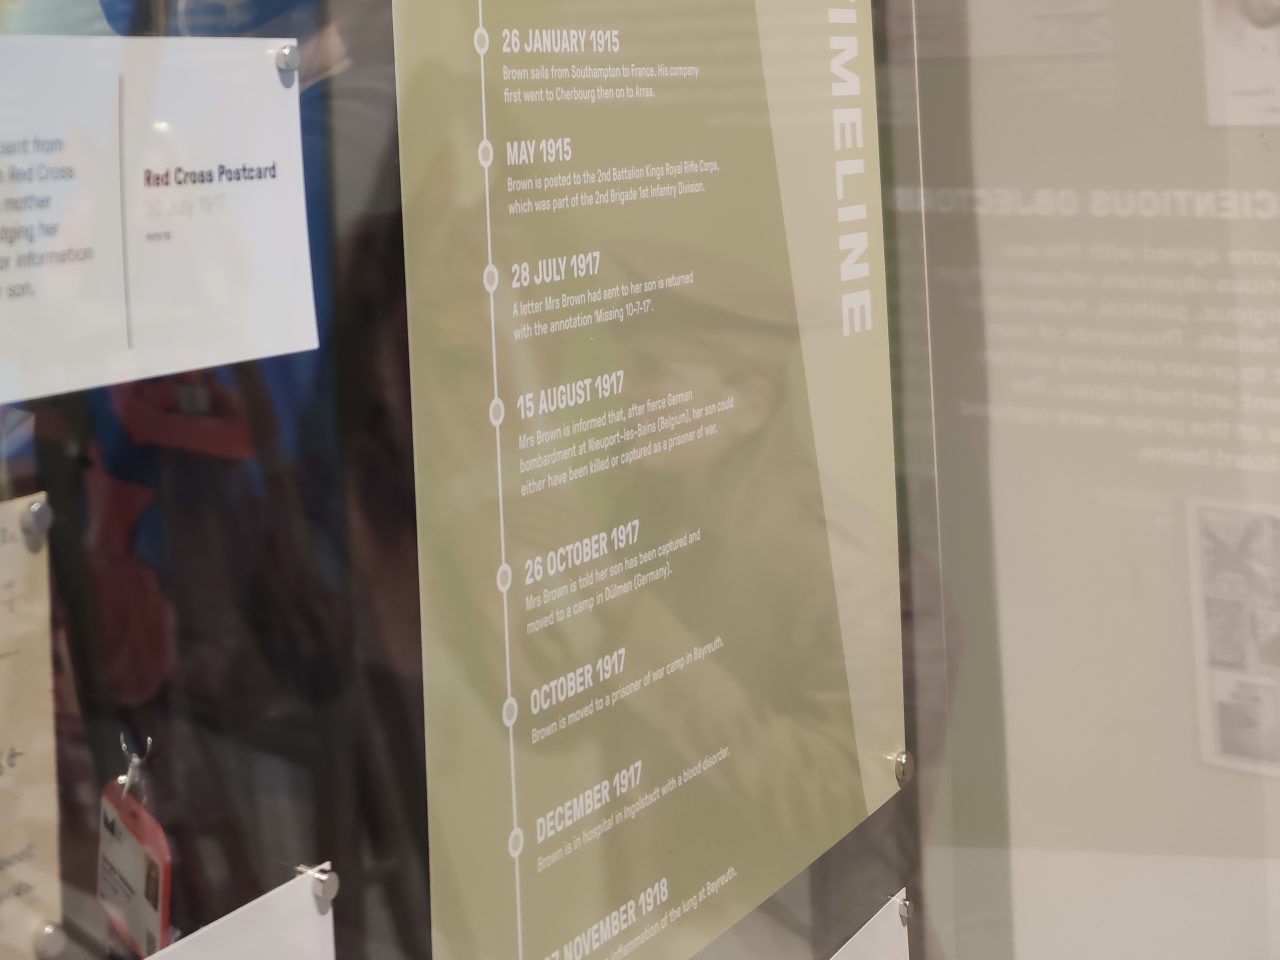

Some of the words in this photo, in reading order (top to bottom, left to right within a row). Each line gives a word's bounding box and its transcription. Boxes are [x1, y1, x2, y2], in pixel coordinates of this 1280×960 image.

[502, 28, 521, 53] 26
[524, 29, 587, 53] JANUARY
[590, 30, 620, 53] 1915
[503, 65, 529, 81] Brown
[531, 65, 550, 80] sails
[551, 65, 570, 80] from
[571, 64, 621, 81] Southampton
[622, 64, 630, 78] to
[631, 64, 657, 78] France.
[658, 64, 669, 77] His
[669, 66, 699, 79] company
[504, 88, 522, 103] first
[523, 88, 545, 102] went
[545, 88, 554, 102] to
[556, 86, 596, 103] Cherbourg
[597, 85, 614, 100] then
[615, 88, 625, 99] on
[626, 85, 634, 98] to
[635, 85, 656, 98] Arras.
[507, 140, 536, 166] MAY
[539, 138, 572, 163] 1915
[145, 169, 170, 187] Red
[175, 167, 214, 186] Cross
[218, 163, 277, 182] Postcard
[507, 177, 534, 192] Brown
[535, 176, 543, 189] is
[544, 172, 572, 191] posted
[573, 172, 582, 185] to
[582, 170, 596, 185] the
[597, 168, 611, 183] 2nd
[612, 166, 645, 182] Battalion
[645, 164, 665, 180] Kings
[665, 162, 683, 177] Royal
[684, 160, 699, 174] Rifle
[699, 159, 720, 174] Corps,
[508, 198, 533, 215] which
[535, 199, 551, 212] was
[553, 194, 570, 211] part
[571, 193, 579, 208] of
[580, 192, 594, 207] the
[595, 190, 609, 205] 2nd
[610, 187, 638, 204] Brigade
[639, 186, 650, 200] 1st
[650, 183, 677, 198] Infantry
[678, 181, 705, 195] Division.
[512, 262, 530, 289] 28
[534, 256, 567, 285] JULY
[570, 251, 601, 278] 1917
[512, 302, 519, 318] A
[520, 300, 544, 316] letter
[545, 296, 561, 311] Mrs
[562, 293, 586, 308] Brown
[587, 287, 602, 303] had
[603, 284, 621, 300] sent
[621, 283, 629, 297] to
[630, 281, 643, 295] her
[644, 280, 657, 293] son
[658, 276, 665, 289] is
[665, 271, 694, 288] returned
[513, 323, 533, 341] with
[533, 321, 549, 336] the
[550, 312, 593, 333] annotation
[517, 392, 535, 420] 15
[539, 378, 592, 415] AUGUST
[595, 370, 624, 399] 1917
[525, 556, 543, 585] 26
[547, 532, 609, 576] OCTOBER
[611, 519, 640, 551] 1917
[531, 664, 594, 715] OCTOBER
[596, 647, 626, 682] 1917
[537, 780, 610, 844] DECEMBER
[613, 760, 642, 797] 1917
[563, 899, 637, 960] NOVEMBER
[638, 877, 669, 916] 1918
